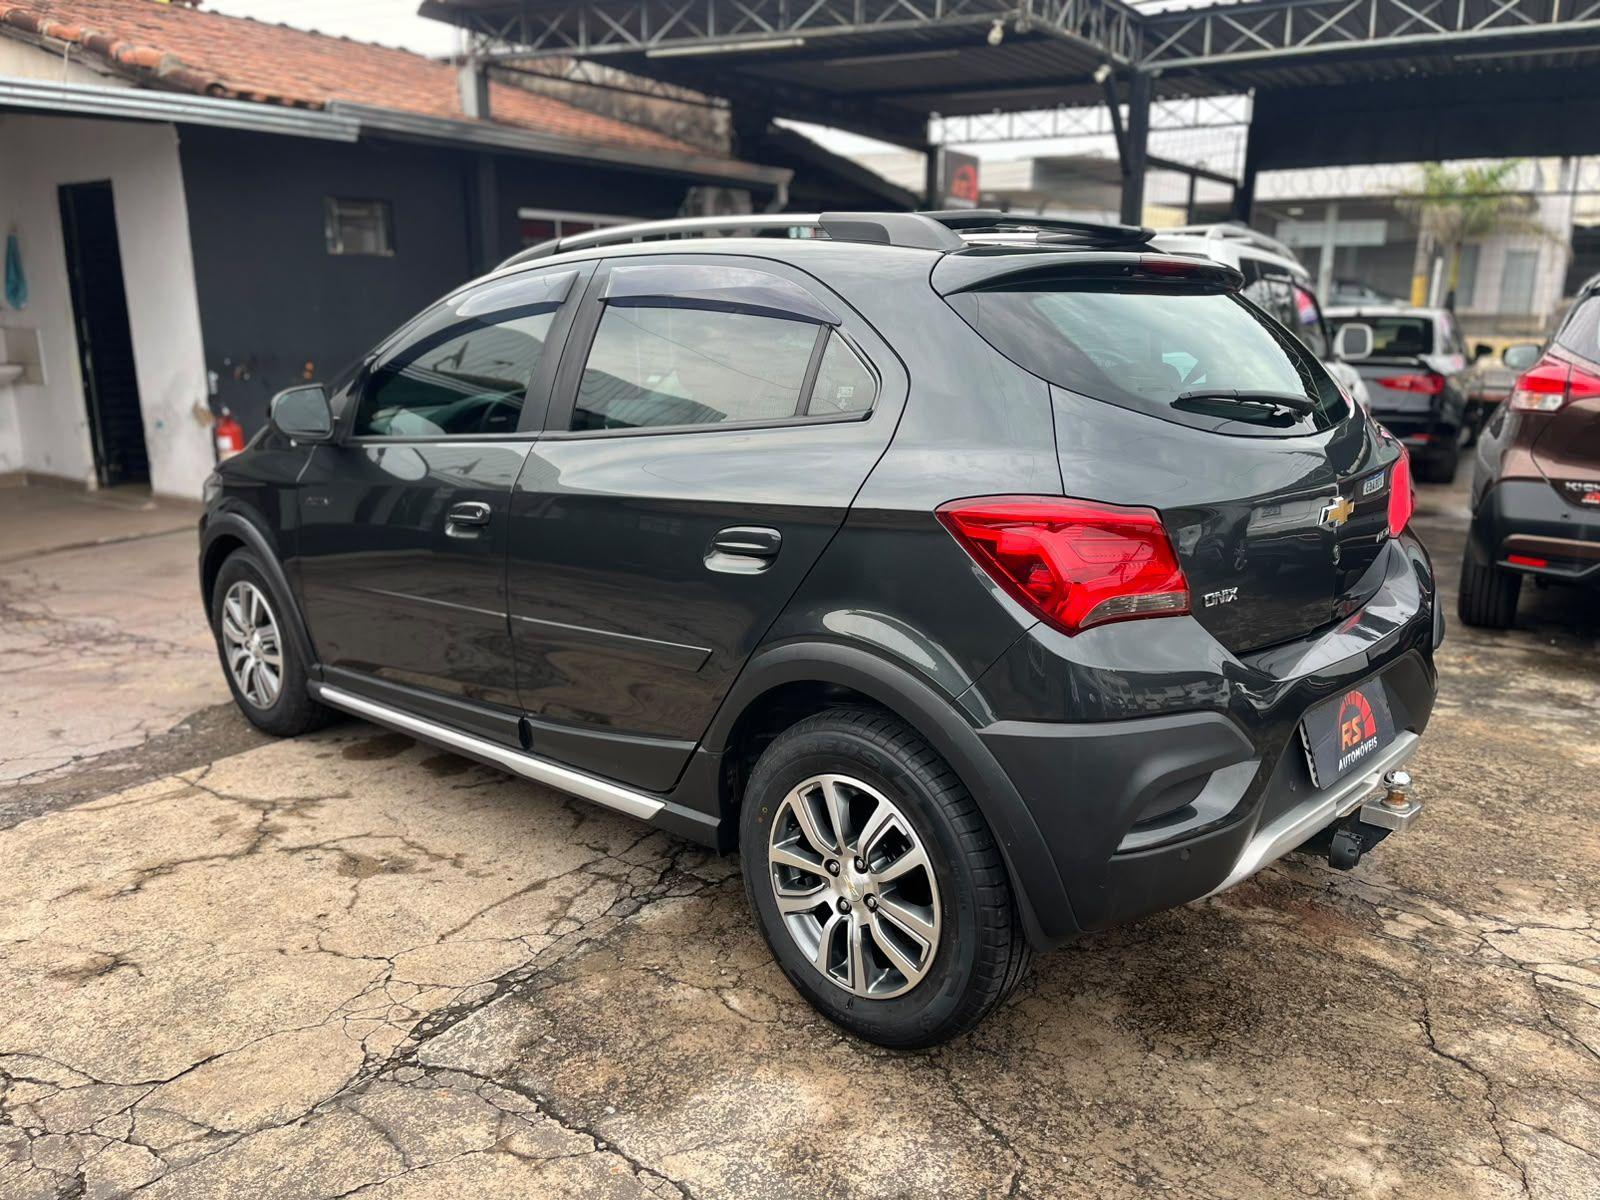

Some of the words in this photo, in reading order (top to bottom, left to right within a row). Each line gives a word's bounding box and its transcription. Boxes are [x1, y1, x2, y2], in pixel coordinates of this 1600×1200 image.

[1204, 587, 1238, 607] ONIX
[1341, 714, 1362, 752] RS
[1338, 736, 1378, 772] AUTOMÓVEIS
